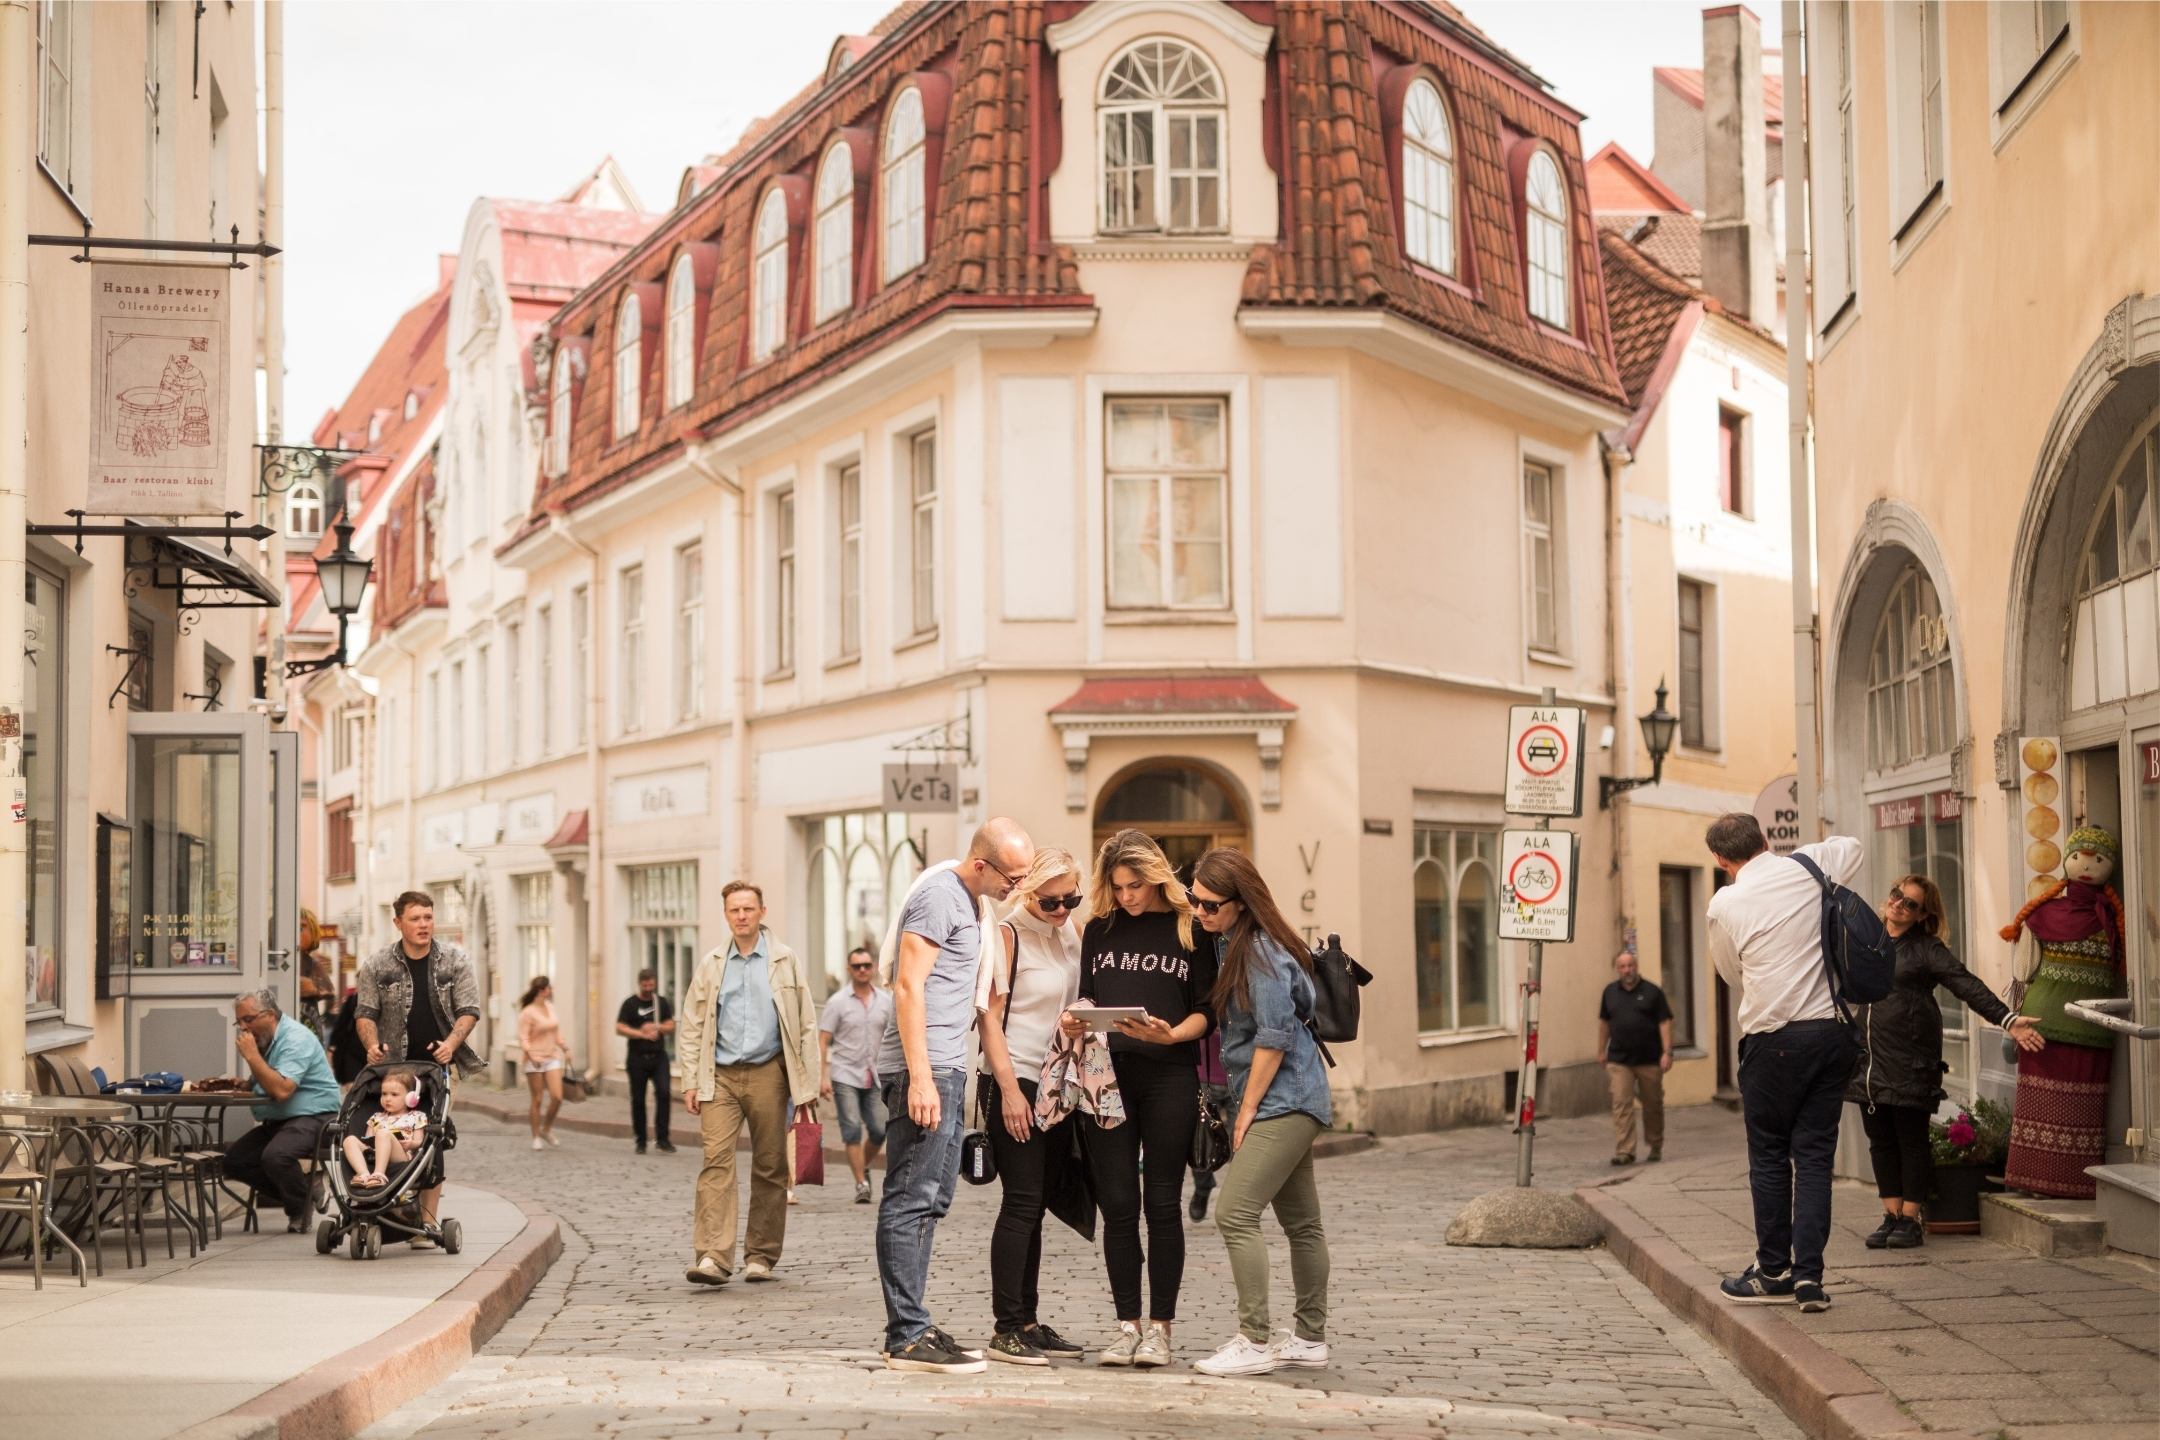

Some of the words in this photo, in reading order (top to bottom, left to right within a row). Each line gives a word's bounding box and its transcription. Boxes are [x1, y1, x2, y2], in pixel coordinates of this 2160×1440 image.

[103, 282, 150, 294] Hansa
[158, 284, 220, 299] Brewery
[103, 475, 127, 484] Baar
[134, 476, 179, 485] restoran
[186, 476, 214, 486] klubi
[1531, 711, 1558, 722] ALA
[891, 777, 952, 802] VeTa
[1775, 809, 1798, 823] PO
[1524, 837, 1550, 848] ALA
